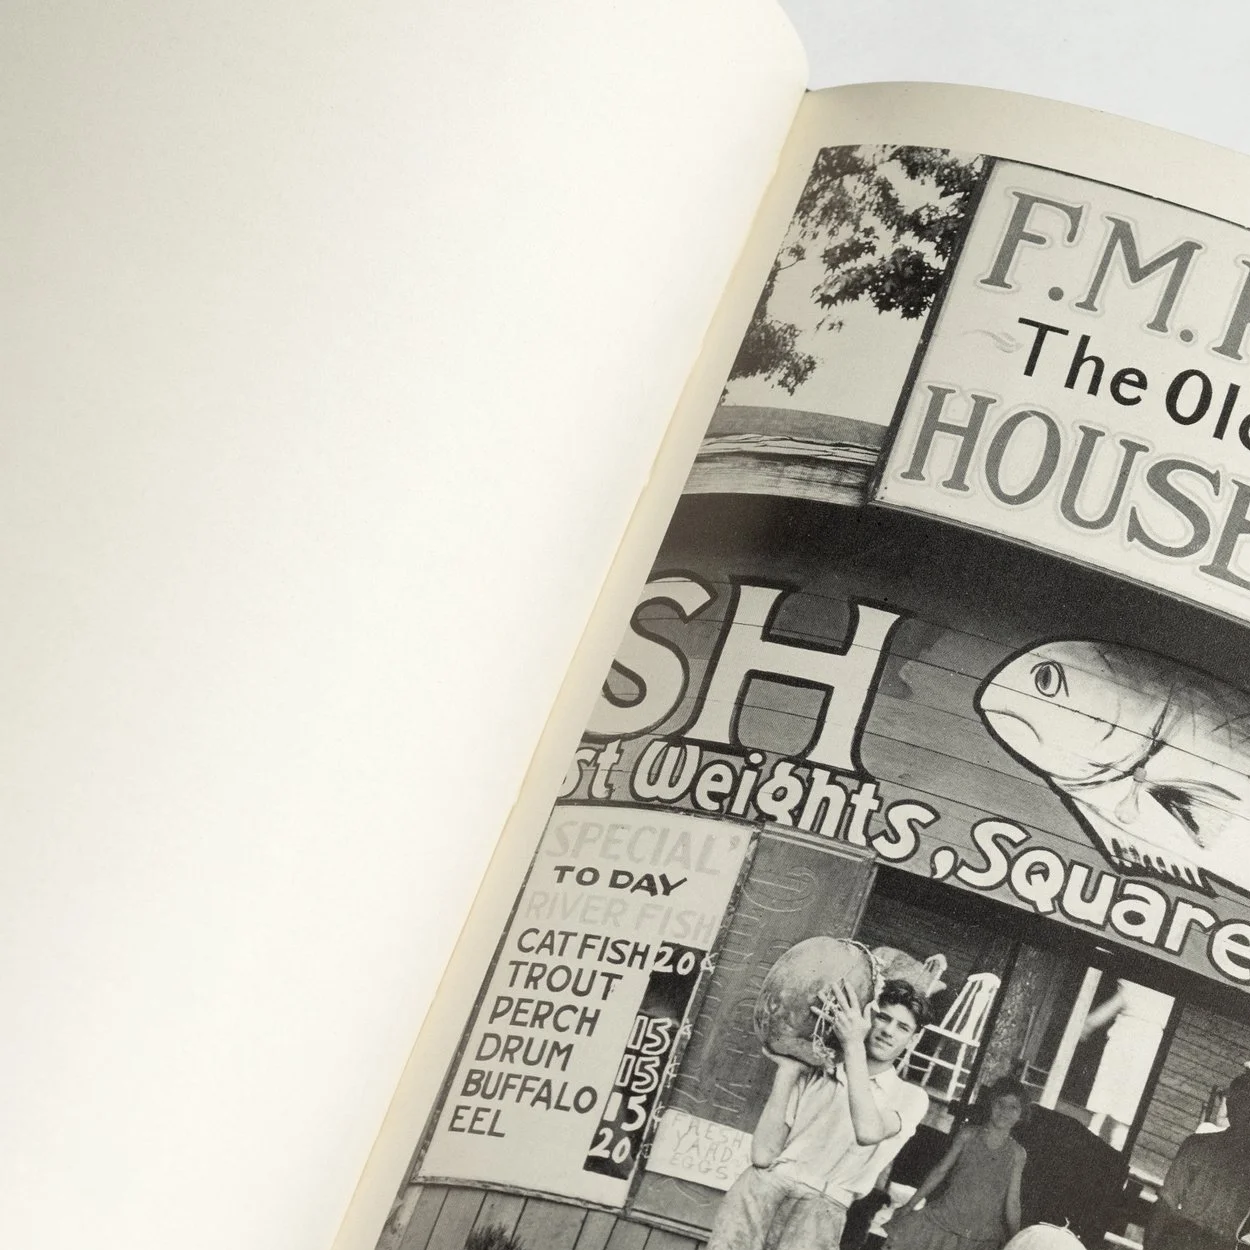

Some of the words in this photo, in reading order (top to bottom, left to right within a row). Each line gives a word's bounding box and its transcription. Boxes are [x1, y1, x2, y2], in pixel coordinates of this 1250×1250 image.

[1017, 317, 1149, 406] The
[524, 890, 628, 928] RIVER
[634, 903, 718, 944] FISH
[508, 960, 623, 1000] TROUT
[489, 996, 601, 1037] PERCH
[475, 1033, 574, 1071] DRUM
[460, 1069, 598, 1115] BUFFALO
[448, 1105, 506, 1138] EEL
[669, 1152, 728, 1181] EGGS
